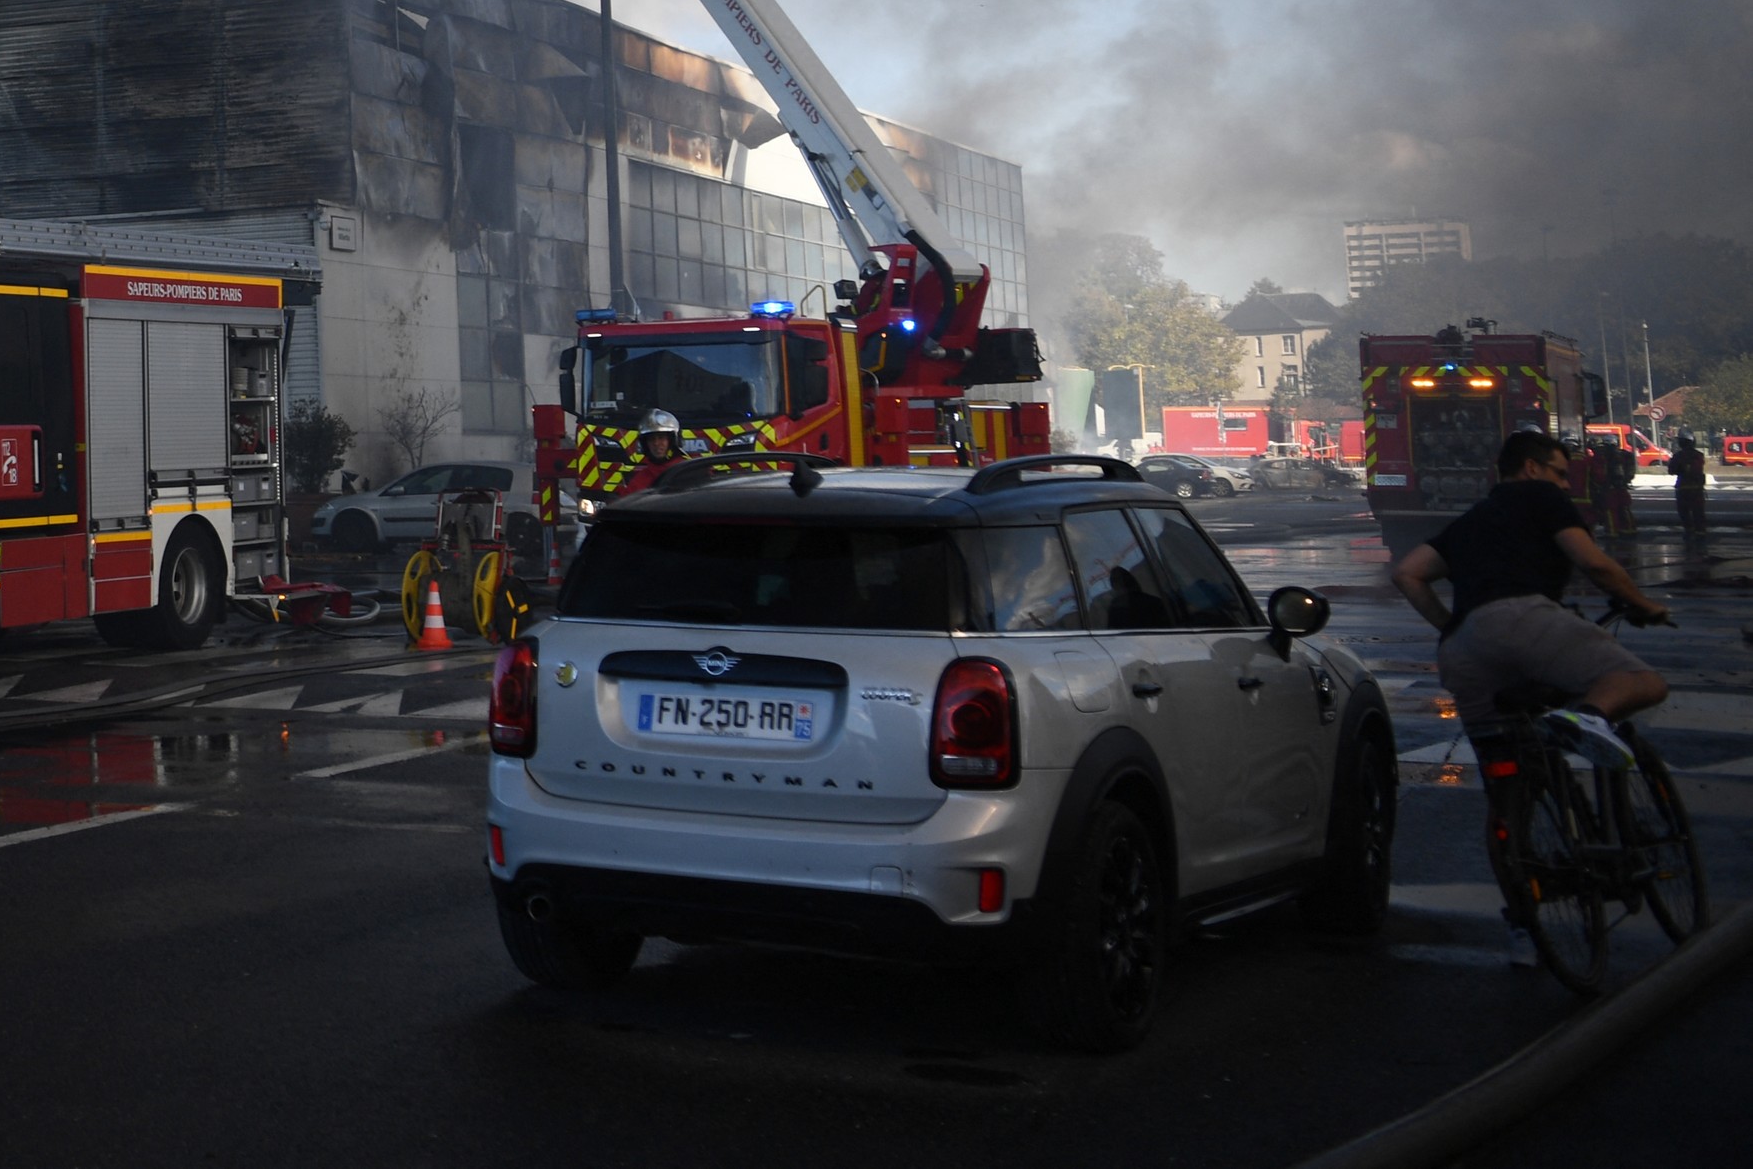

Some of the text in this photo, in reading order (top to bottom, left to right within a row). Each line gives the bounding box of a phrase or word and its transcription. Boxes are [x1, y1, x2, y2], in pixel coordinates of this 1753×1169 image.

[764, 49, 783, 75] DE
[785, 78, 820, 125] PARIS
[127, 281, 243, 302] SAPEURS-POMPIERS DE PARIS
[8, 467, 17, 484] 18
[658, 696, 794, 731] FN-250-RR
[796, 720, 812, 737] 75
[575, 760, 873, 790] COUNTRYMAN
